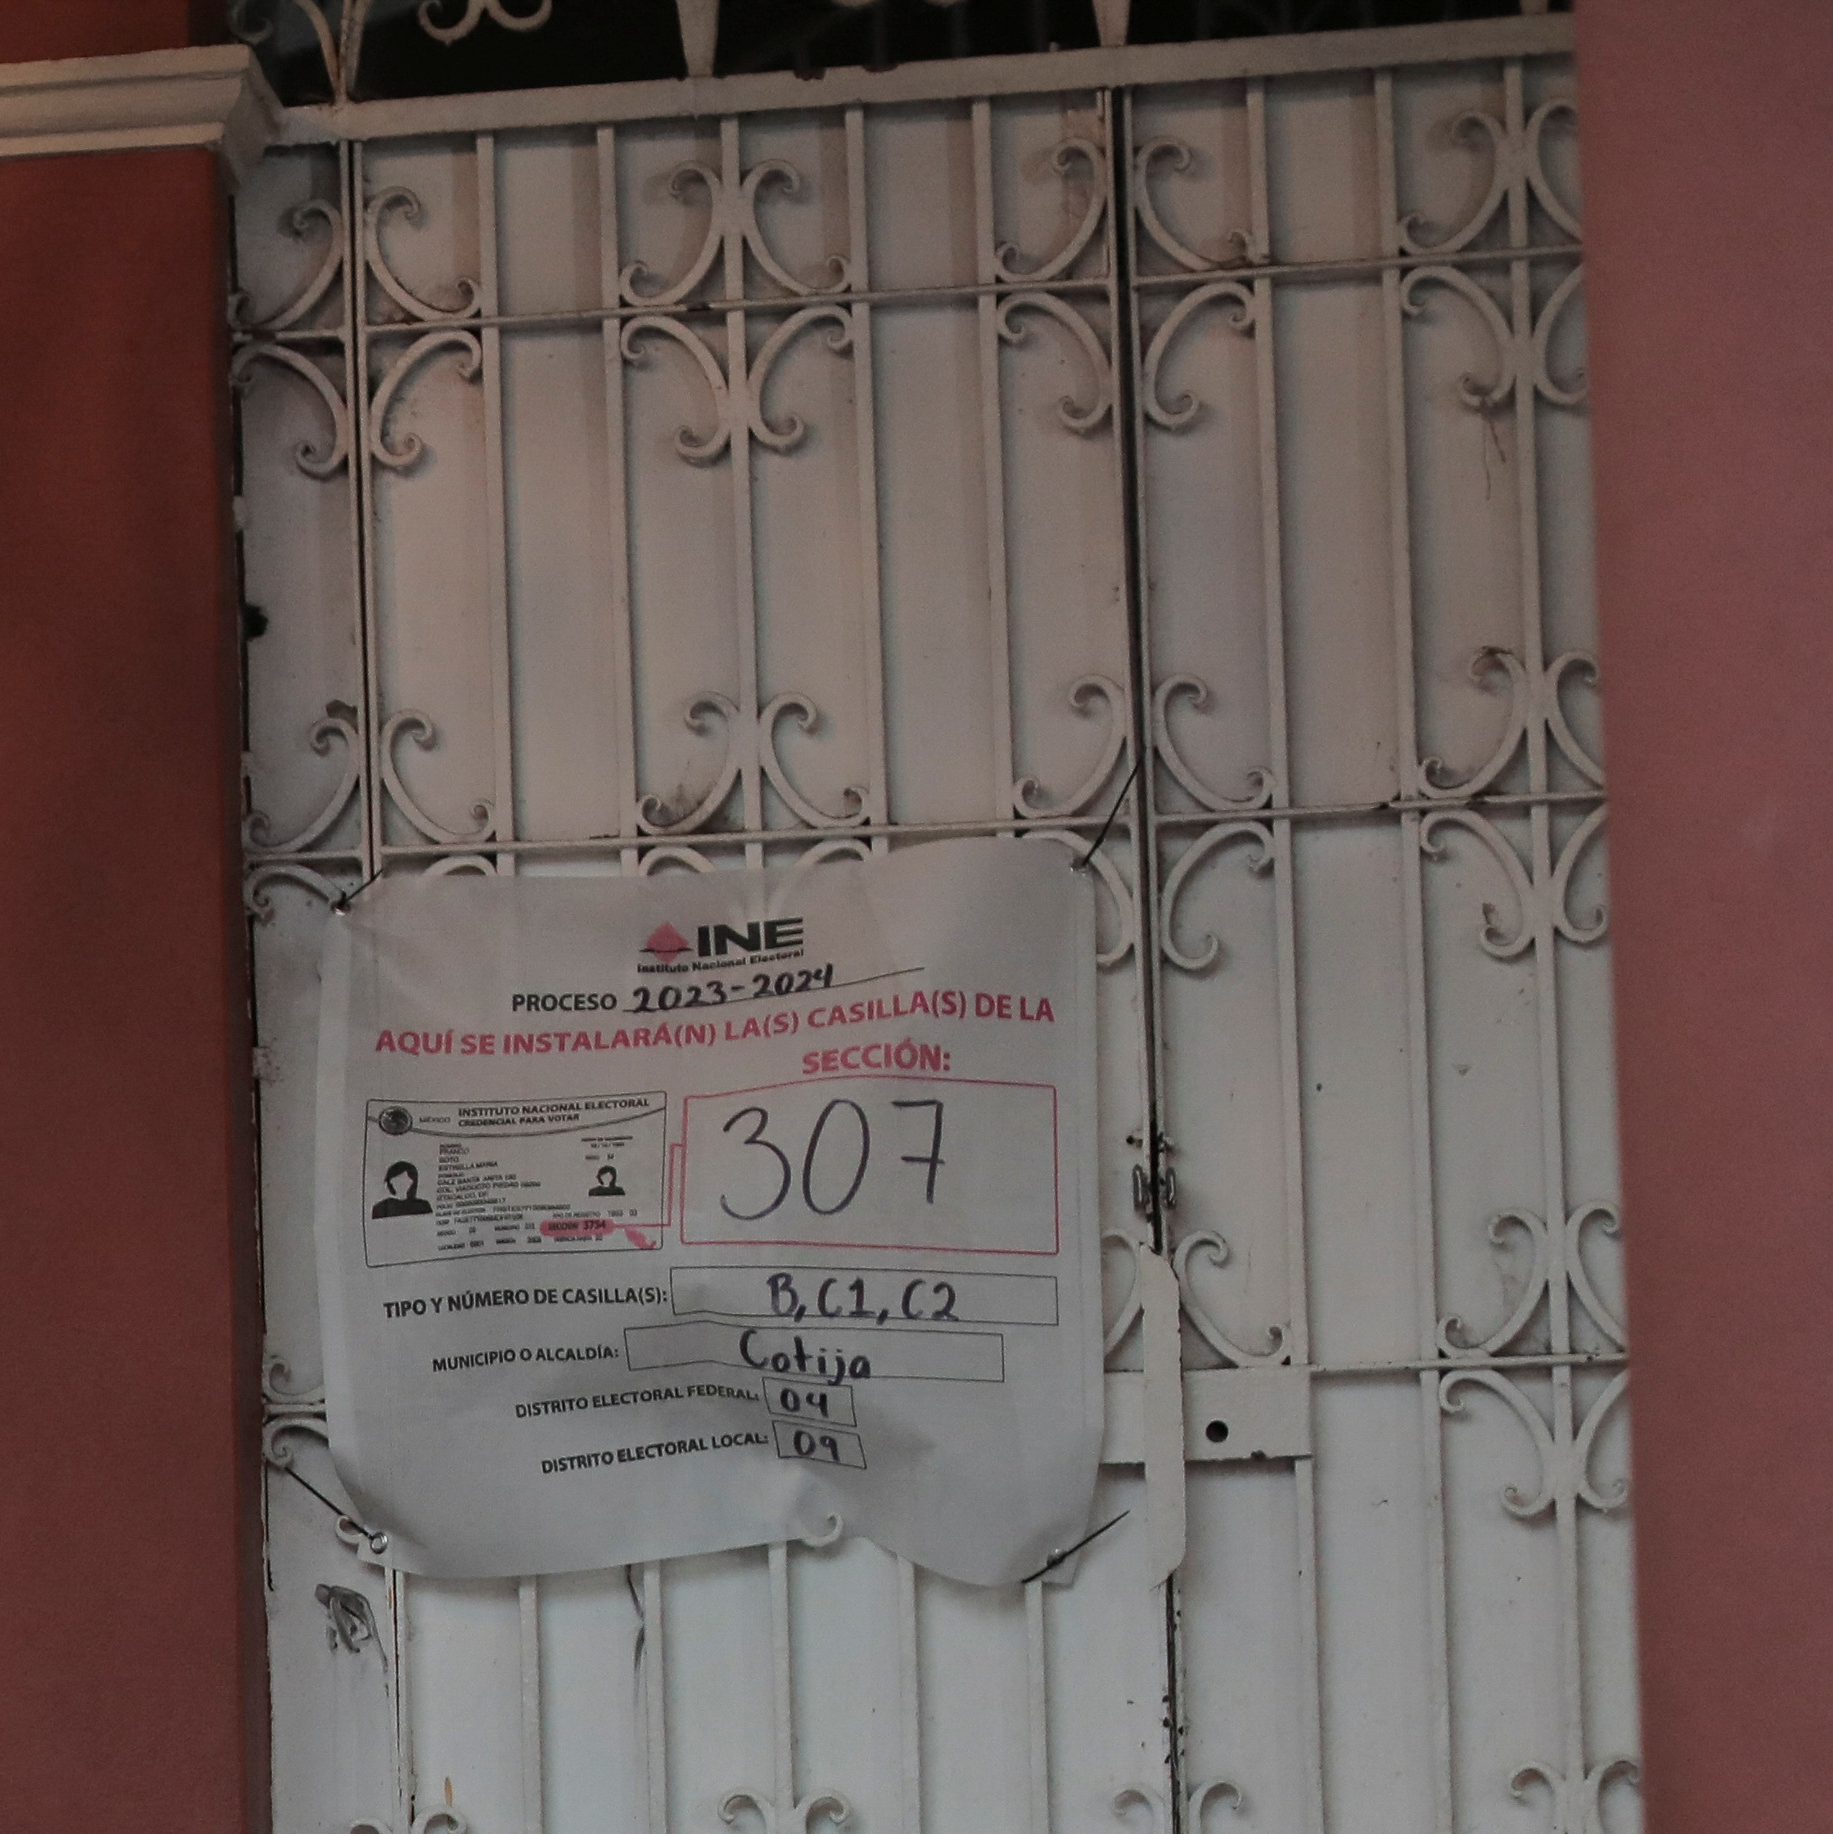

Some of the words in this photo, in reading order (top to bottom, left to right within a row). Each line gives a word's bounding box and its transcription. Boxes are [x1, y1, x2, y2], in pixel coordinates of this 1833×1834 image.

[697, 916, 804, 957] INE
[637, 962, 690, 974] Instituto
[692, 956, 747, 971] Nacional
[750, 949, 804, 965] Electoral
[512, 993, 618, 1012] PROCESO
[375, 1029, 455, 1056] AQUÍ
[460, 1032, 496, 1055] SE
[503, 1021, 718, 1056] INSTALARÁ(N)
[725, 1010, 800, 1041] LA(S)
[807, 990, 968, 1029] CASILLA(S)
[975, 992, 1013, 1019] DE
[1020, 996, 1056, 1023] LA
[802, 1036, 951, 1075] SECCIÓN:
[459, 1107, 520, 1118] INSTITUTO
[522, 1103, 582, 1116] NACIONAL
[584, 1098, 650, 1111] ELECTORAL
[459, 1118, 516, 1128] CREDENCIAL
[519, 1115, 545, 1125] PARA
[548, 1113, 580, 1123] VOTAR
[721, 1098, 946, 1220] 307
[384, 1299, 427, 1319] TIPO
[431, 1298, 444, 1313] Y
[447, 1288, 530, 1312] NÚMERO
[535, 1287, 558, 1304] DE
[561, 1286, 668, 1306] CASILLA(S):
[432, 1348, 516, 1373] MUNICIPIO
[519, 1348, 533, 1362] O
[535, 1344, 620, 1362] ALCALDÍA:
[738, 1328, 872, 1386] Cotija
[515, 1397, 589, 1418] DISTRITO
[592, 1385, 683, 1409] ELECTORAL
[686, 1384, 760, 1402] FEDERAL:
[779, 1387, 829, 1418] 04
[541, 1451, 614, 1475] DISTRITO
[617, 1436, 709, 1463] ELECTORAL
[711, 1433, 769, 1451] LOCAL:
[793, 1429, 842, 1463] 09
